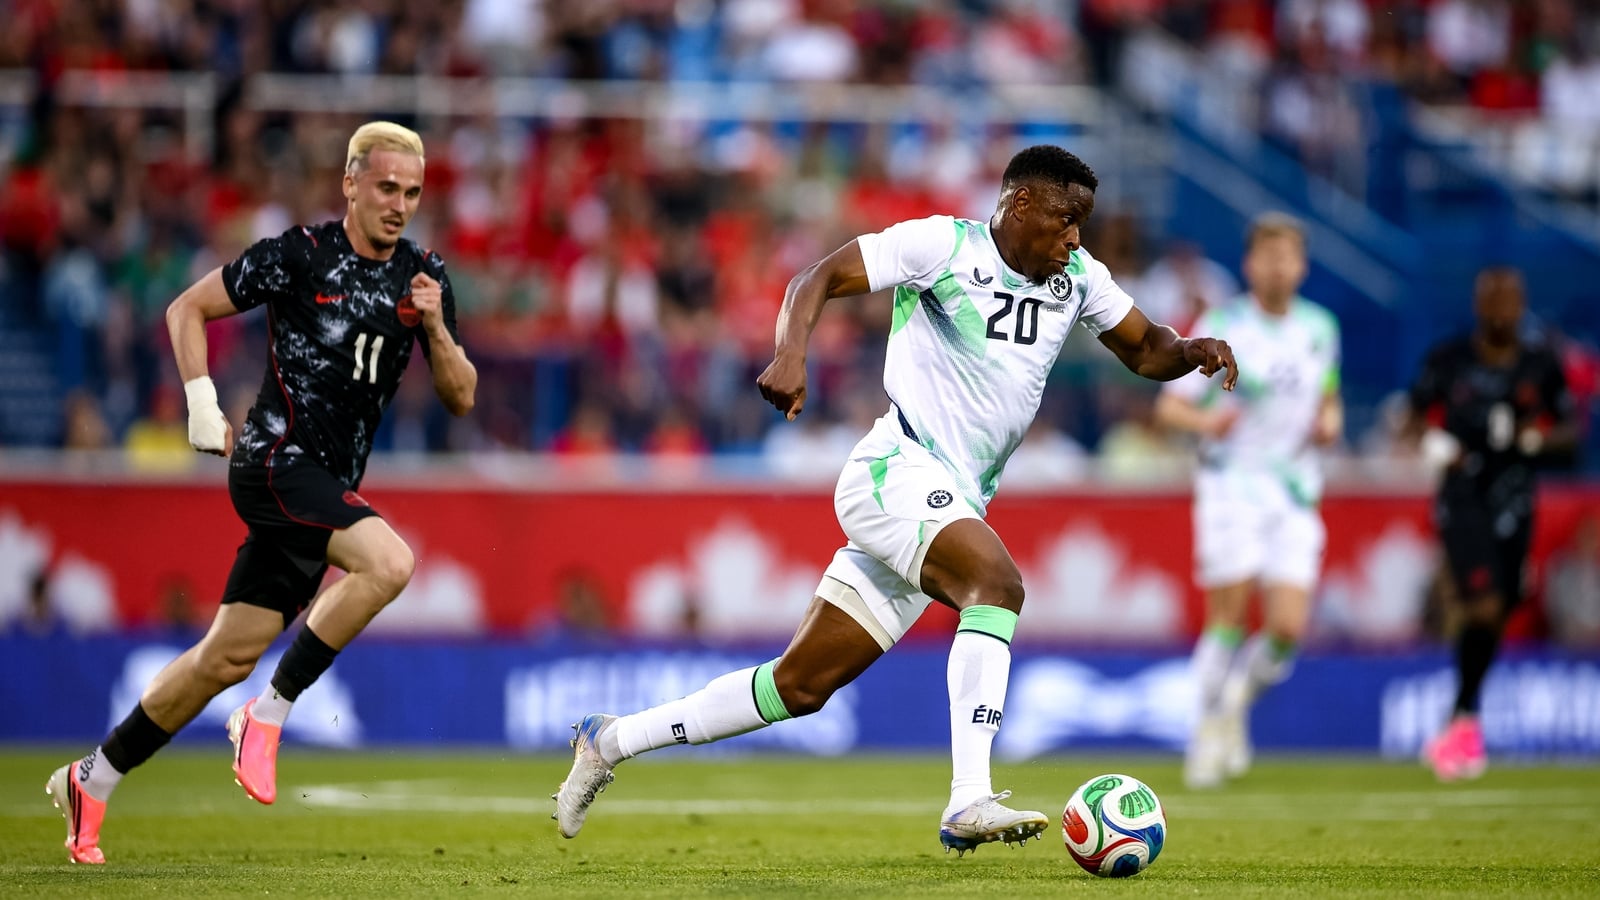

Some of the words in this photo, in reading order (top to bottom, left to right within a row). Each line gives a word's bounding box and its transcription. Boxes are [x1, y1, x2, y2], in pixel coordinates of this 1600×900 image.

[986, 291, 1044, 346] 20
[353, 333, 384, 384] 11
[972, 704, 1003, 727] ÉIR
